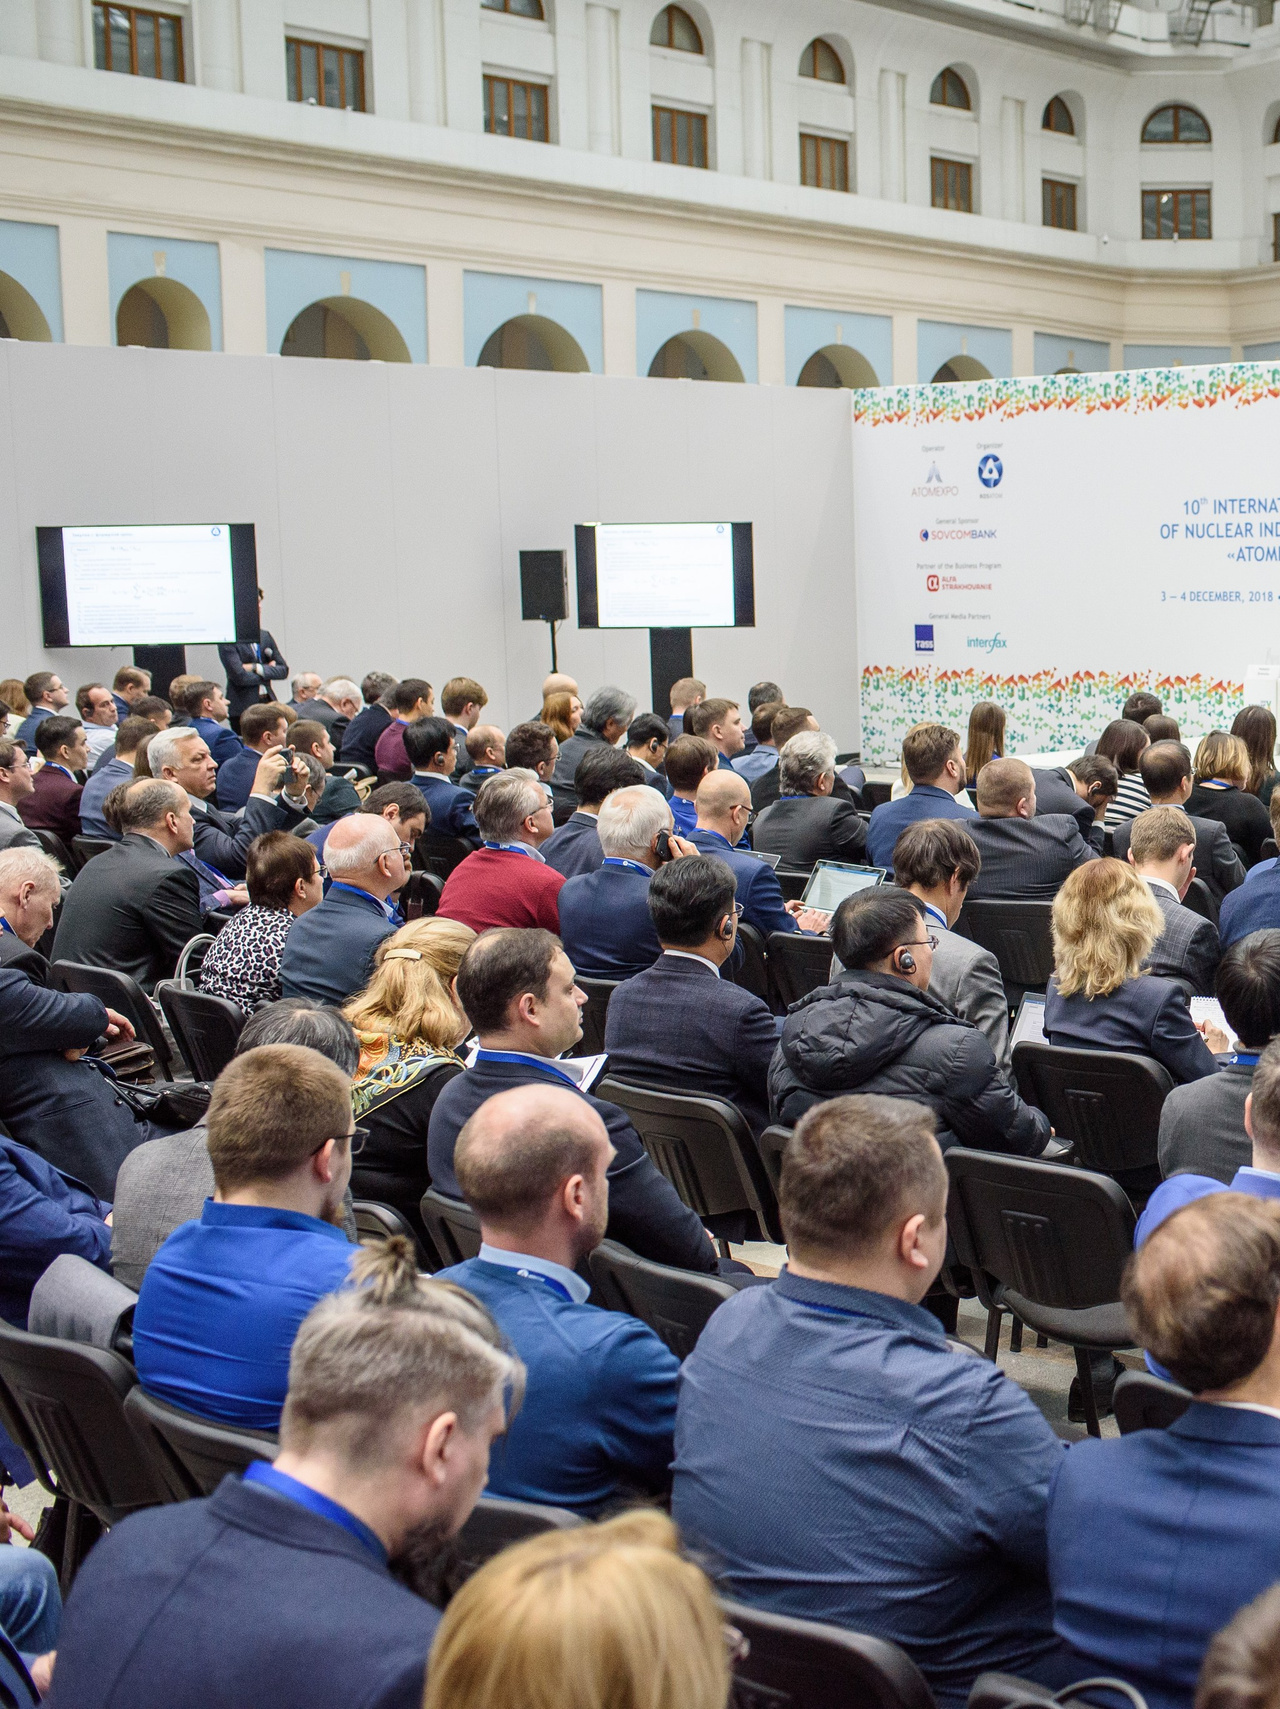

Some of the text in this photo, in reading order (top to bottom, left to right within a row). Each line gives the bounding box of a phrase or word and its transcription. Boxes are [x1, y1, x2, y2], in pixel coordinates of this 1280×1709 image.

[911, 486, 958, 497] ATOMEXPO
[958, 518, 979, 526] Sponsor
[931, 530, 997, 540] SOVCOMBANK
[1160, 523, 1179, 539] OF
[1185, 522, 1254, 539] NUCLEAR
[979, 563, 1002, 571] Program
[1161, 591, 1167, 602] 3
[1180, 591, 1187, 602] 4
[1190, 591, 1245, 603] DECEMBER,
[1249, 591, 1274, 602] 2018
[967, 632, 1007, 654] interfax
